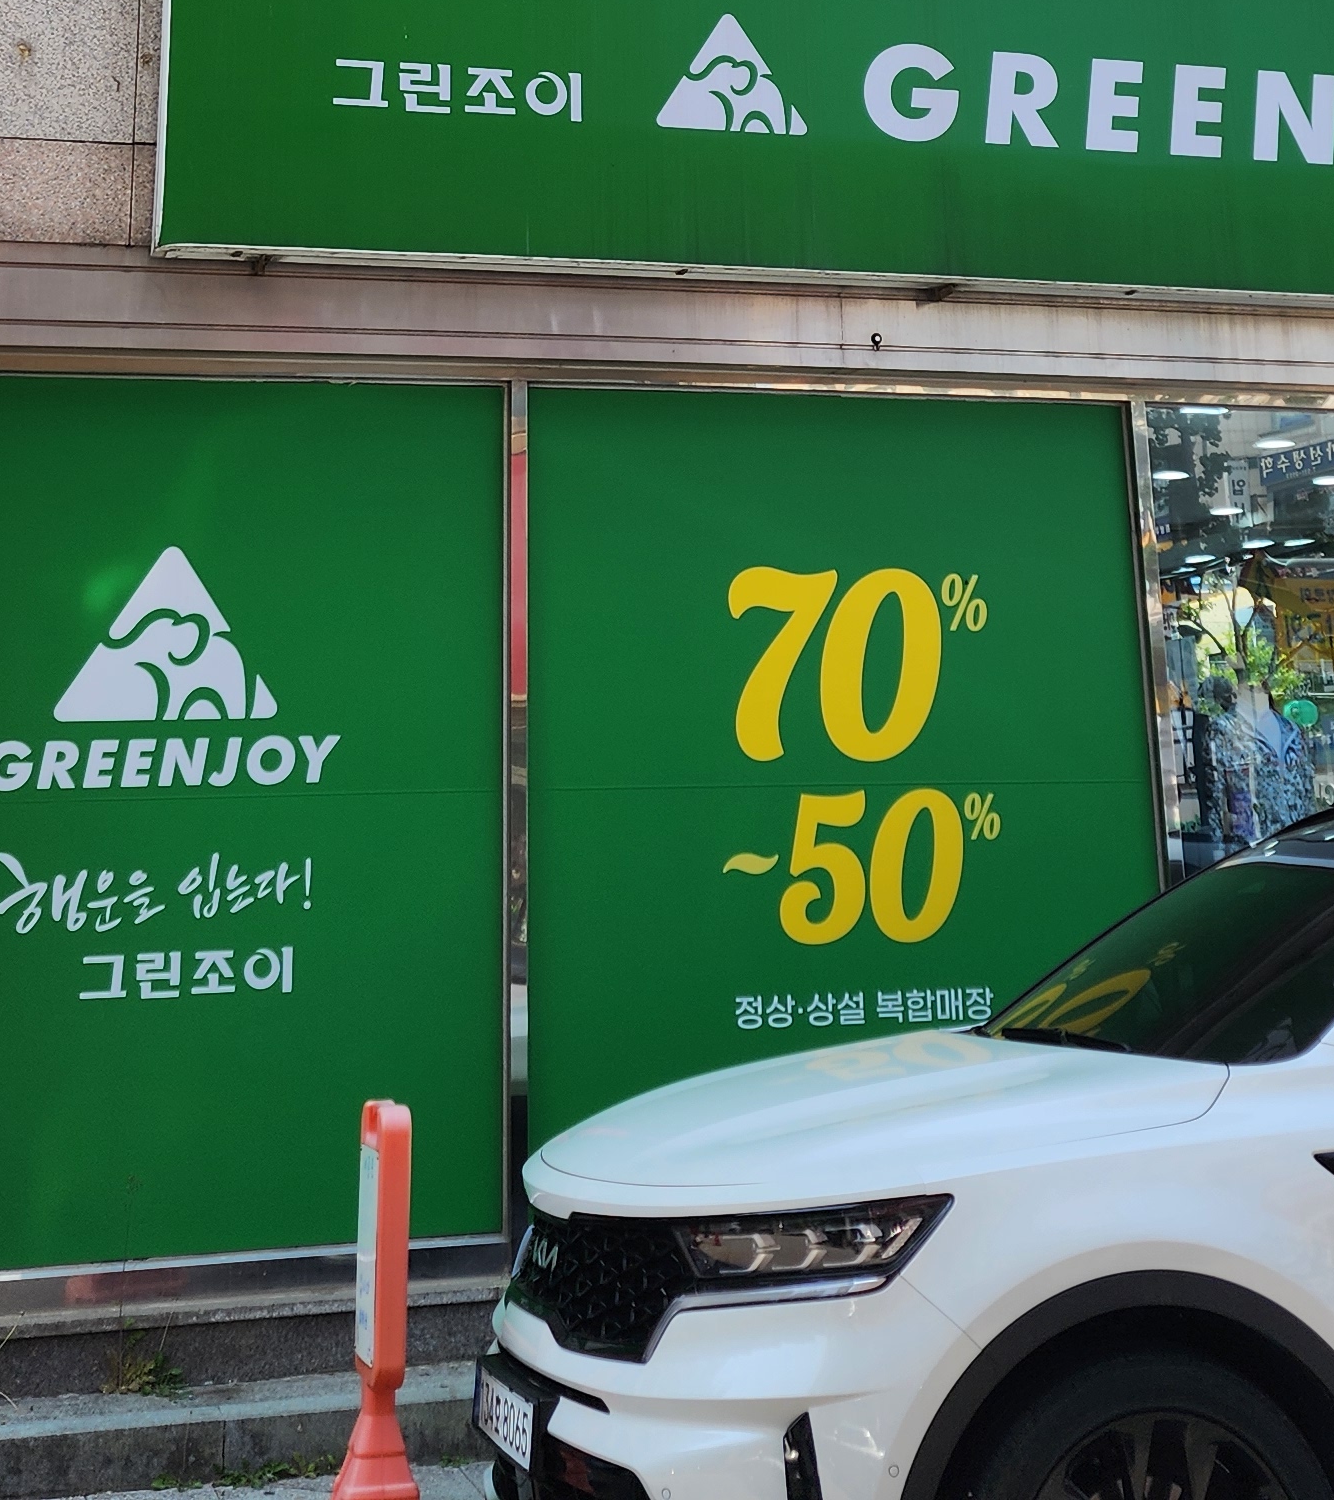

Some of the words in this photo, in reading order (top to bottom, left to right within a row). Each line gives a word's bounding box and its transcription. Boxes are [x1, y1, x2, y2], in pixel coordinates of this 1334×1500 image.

[332, 57, 584, 124] 그린조이
[727, 565, 988, 763] 70%
[177, 851, 313, 920] 입는다!
[78, 945, 295, 1000] 그린조이
[875, 986, 995, 1025] 복합매장
